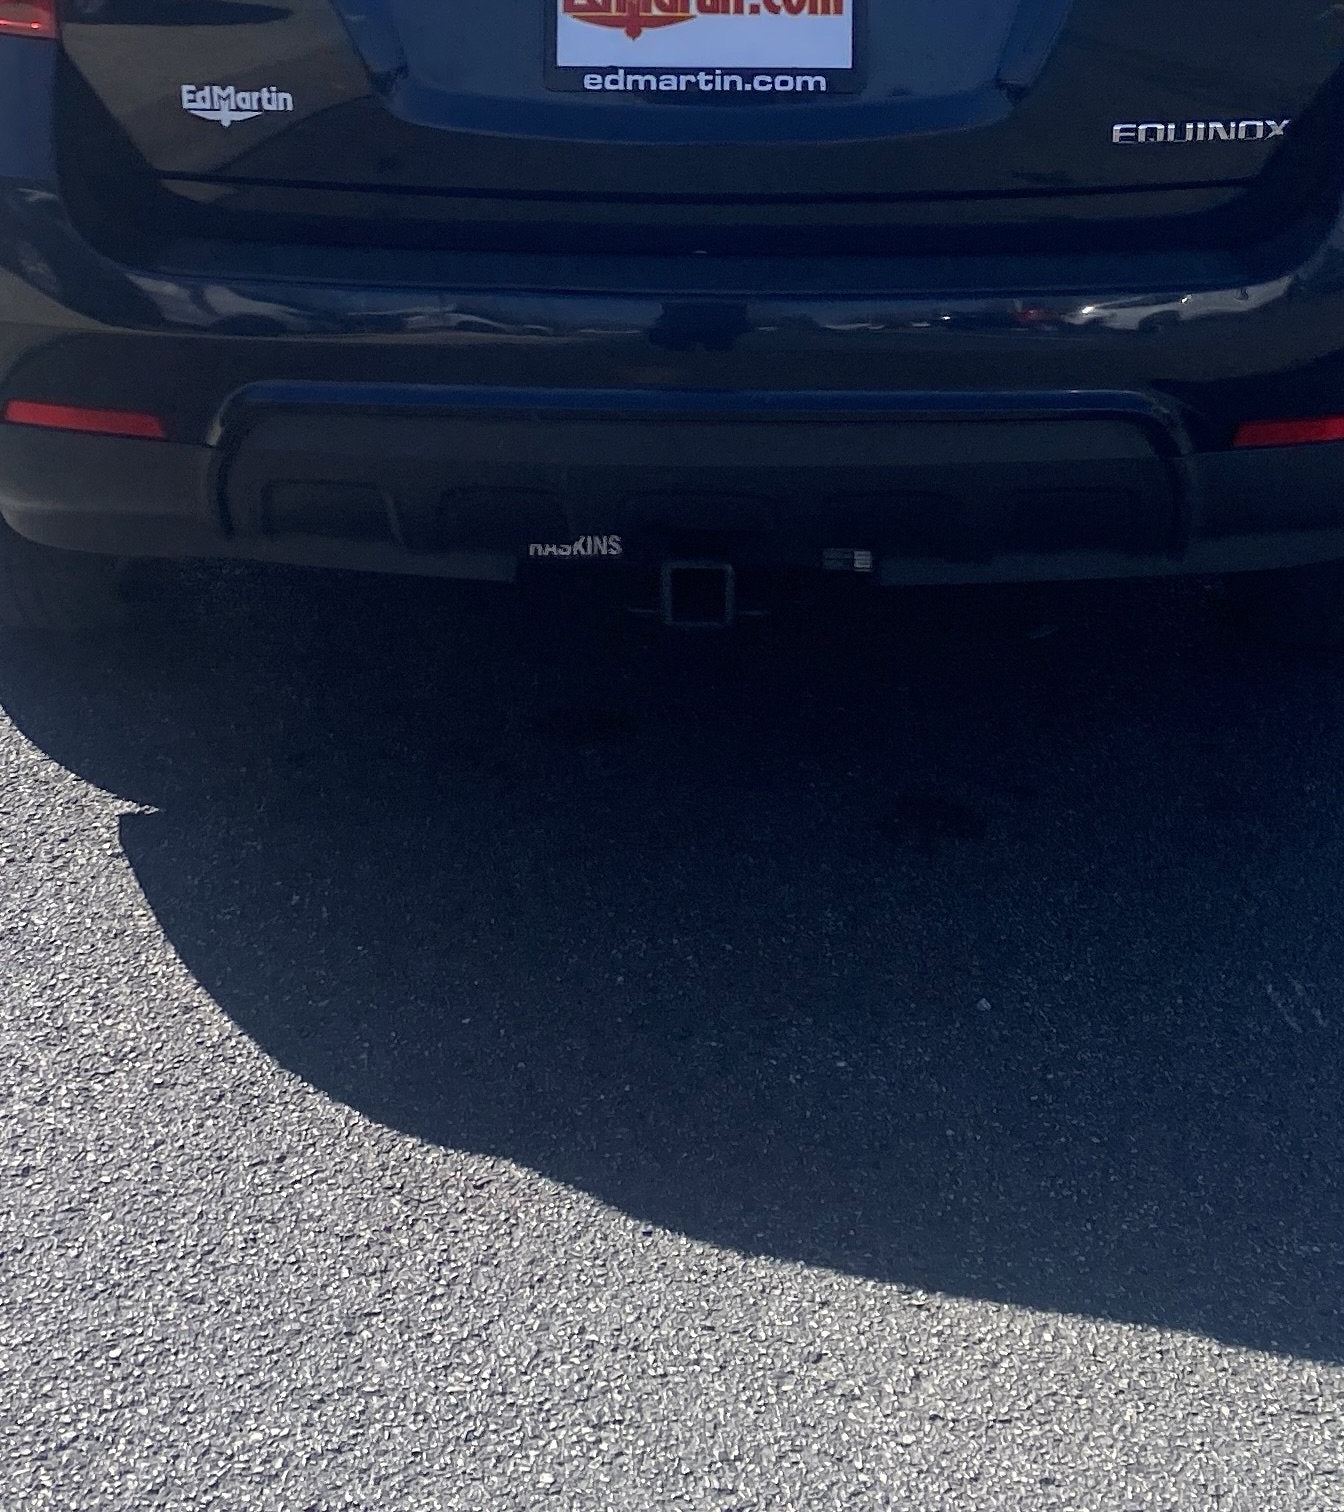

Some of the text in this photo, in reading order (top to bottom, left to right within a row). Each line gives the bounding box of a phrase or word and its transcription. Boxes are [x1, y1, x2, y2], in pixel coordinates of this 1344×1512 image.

[583, 69, 827, 92] edmartin.com
[181, 84, 294, 112] EdMartin
[1112, 119, 1291, 144] EQUINOX
